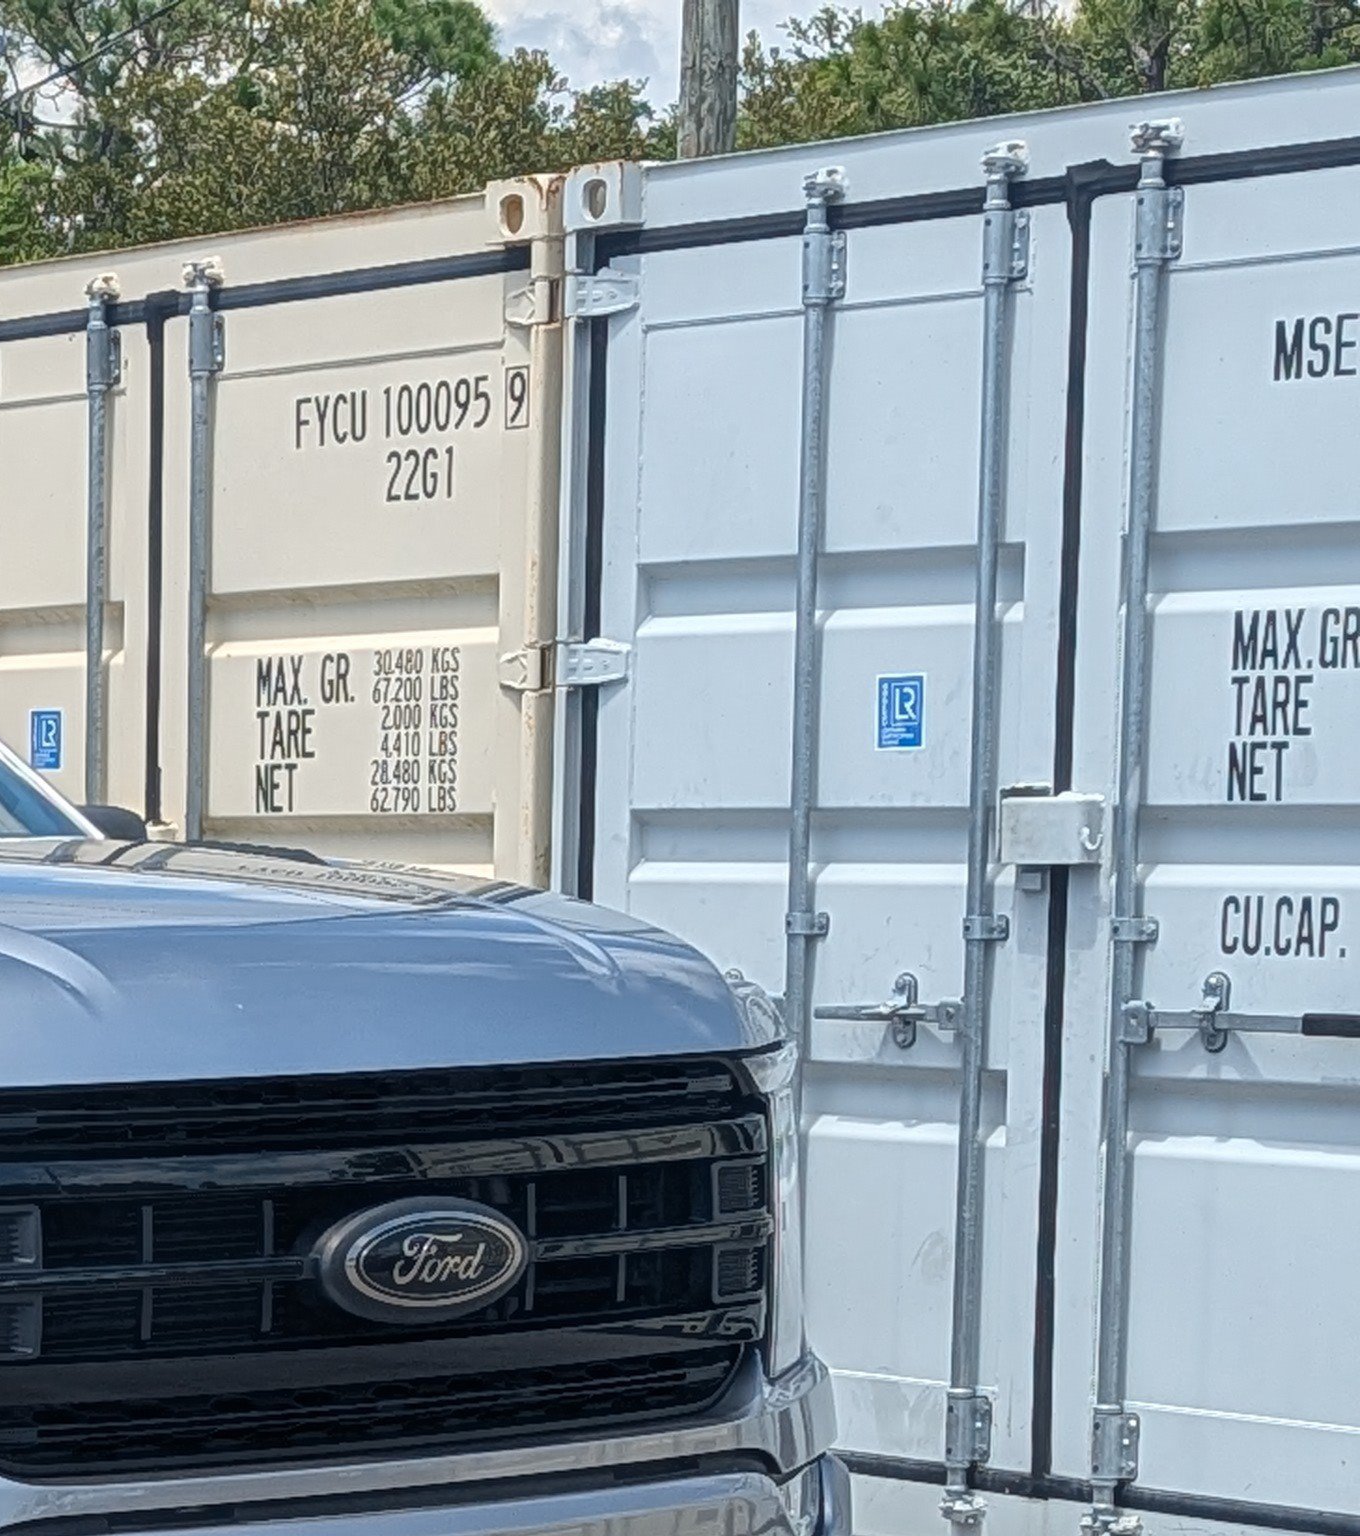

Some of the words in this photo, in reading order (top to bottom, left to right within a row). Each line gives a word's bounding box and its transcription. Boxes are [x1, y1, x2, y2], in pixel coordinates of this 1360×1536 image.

[1273, 313, 1360, 381] MSE
[295, 389, 367, 449] FYCU
[383, 375, 491, 439] 100095
[508, 370, 528, 426] 9
[386, 445, 454, 502] 22G1
[256, 655, 308, 708] MAX.
[320, 652, 355, 704] GR.
[431, 647, 460, 674] KGS
[430, 675, 459, 702] LBS
[1231, 675, 1314, 736] TARE
[256, 708, 315, 760] TARE
[429, 702, 459, 729] KGS
[428, 730, 458, 757] LBS
[255, 763, 298, 813] NET
[428, 758, 457, 784] KGS
[428, 785, 457, 812] LBS
[1227, 740, 1289, 801] NET
[1220, 895, 1347, 958] CU.CAP.
[392, 1232, 486, 1286] Ford
